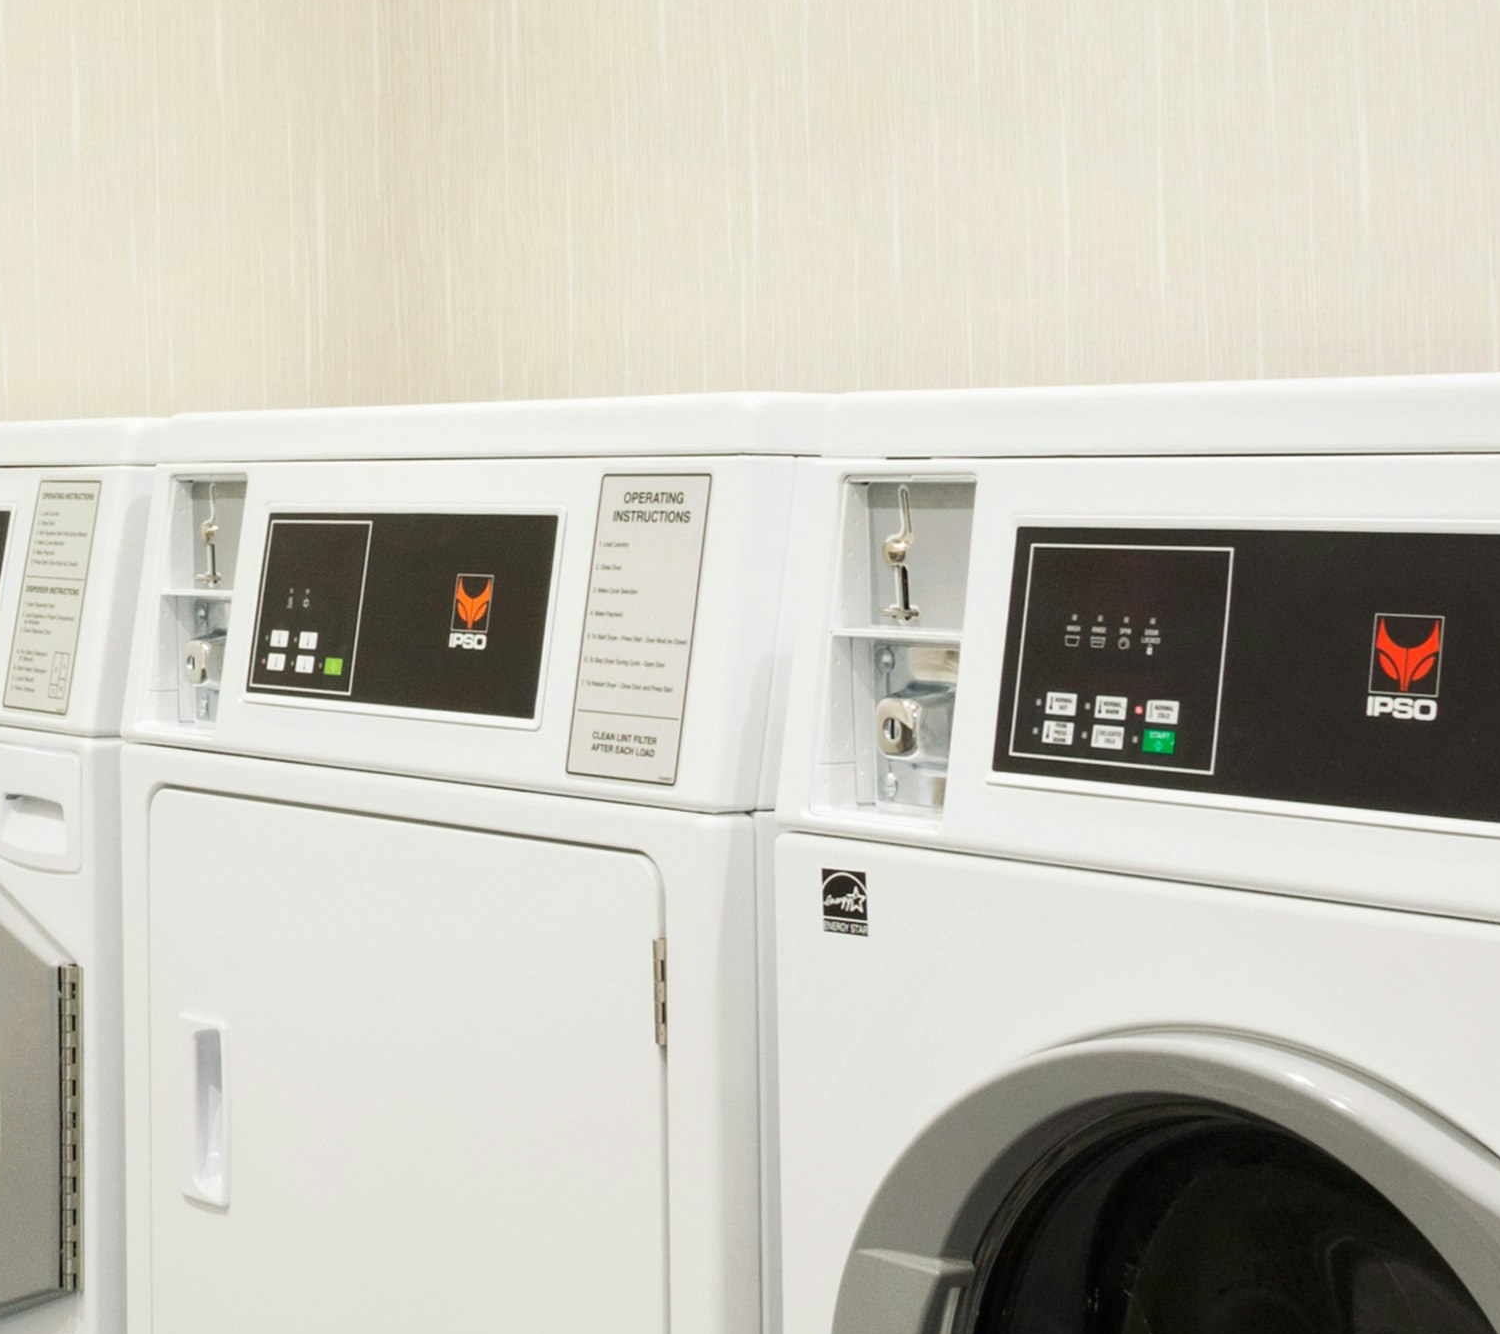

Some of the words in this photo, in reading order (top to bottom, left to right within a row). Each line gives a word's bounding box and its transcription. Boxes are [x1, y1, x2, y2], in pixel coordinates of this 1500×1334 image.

[624, 492, 684, 504] OPERATING
[613, 511, 691, 523] INSTRUCTIONS
[449, 633, 487, 650] IPSO
[1366, 695, 1438, 721] IPSO
[592, 731, 615, 741] CLEAN
[617, 733, 632, 742] LINT
[633, 735, 657, 745] FILTER
[591, 743, 613, 753] AFTER
[615, 746, 634, 755] EACH
[636, 748, 655, 758] LOAD
